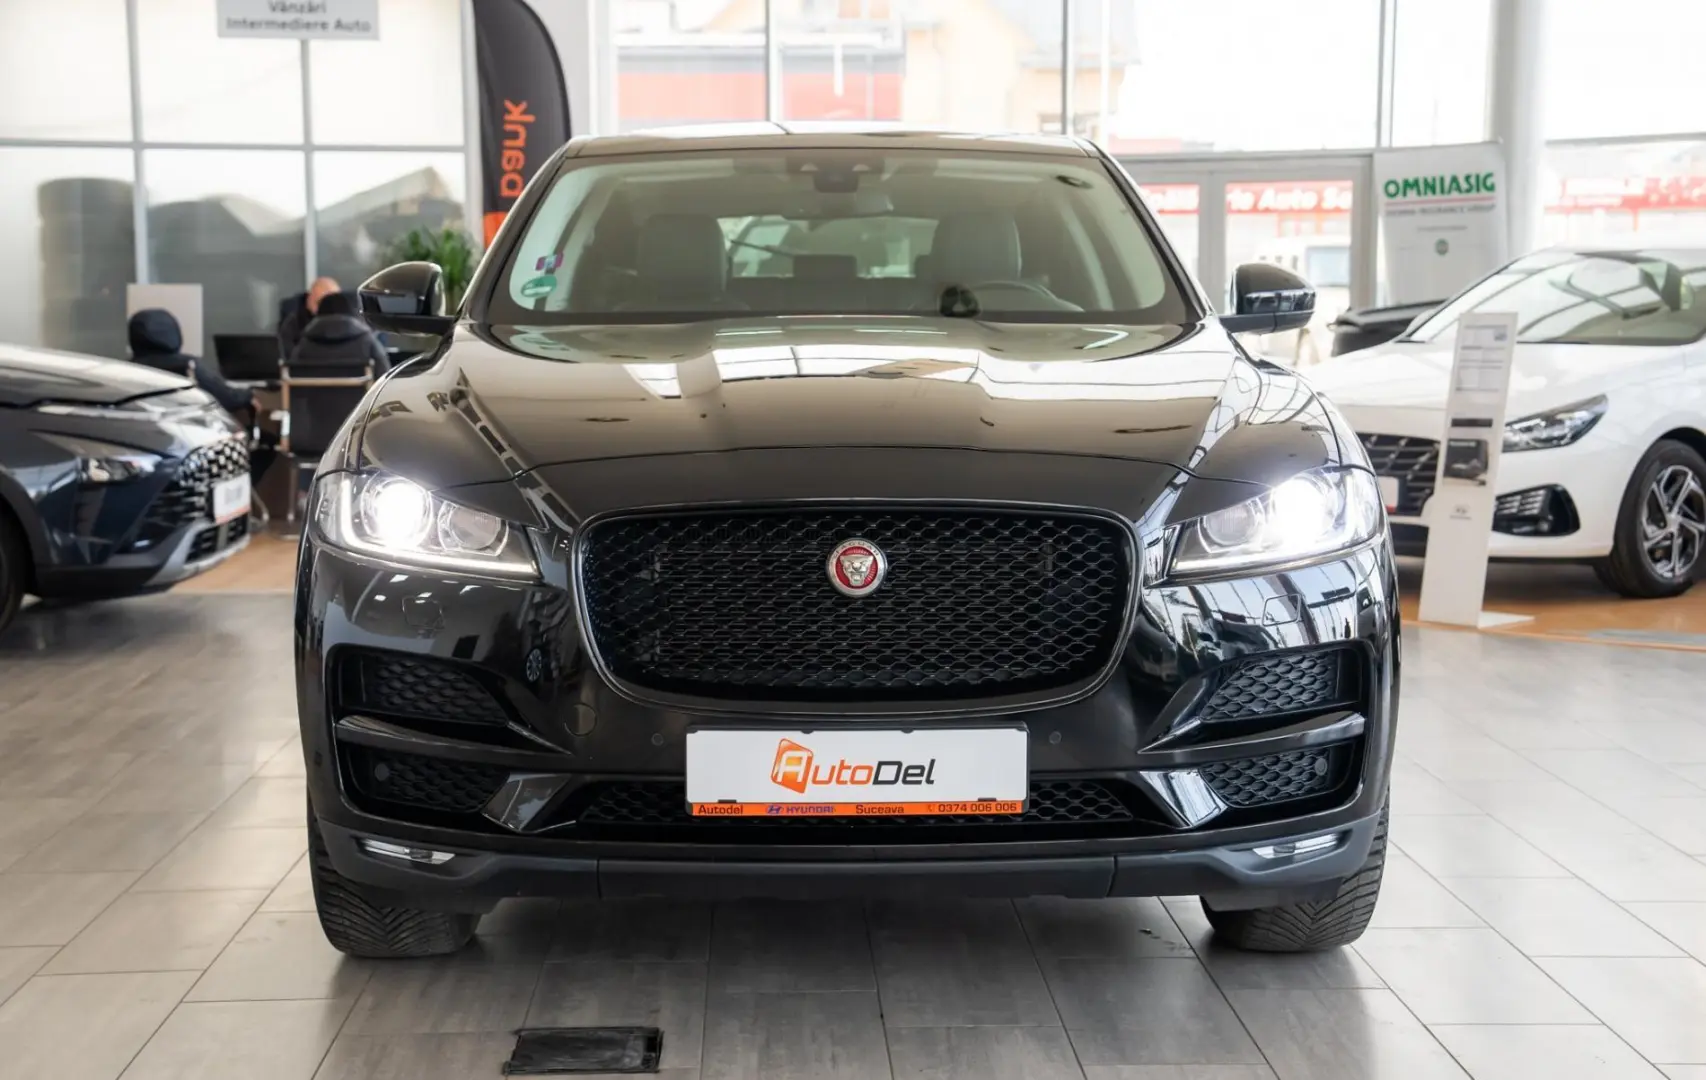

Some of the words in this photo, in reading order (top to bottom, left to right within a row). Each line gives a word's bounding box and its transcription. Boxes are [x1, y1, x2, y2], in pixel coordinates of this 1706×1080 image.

[226, 16, 330, 31] Intermediere
[334, 18, 372, 32] Auto
[1384, 172, 1496, 199] OMNIASIG
[772, 744, 936, 790] AutoDel
[698, 804, 743, 815] Autodel
[786, 806, 834, 814] HYUNDAI
[855, 804, 905, 814] Suceava
[938, 803, 967, 813] 0374
[970, 802, 992, 812] 006
[995, 802, 1017, 812] 006
